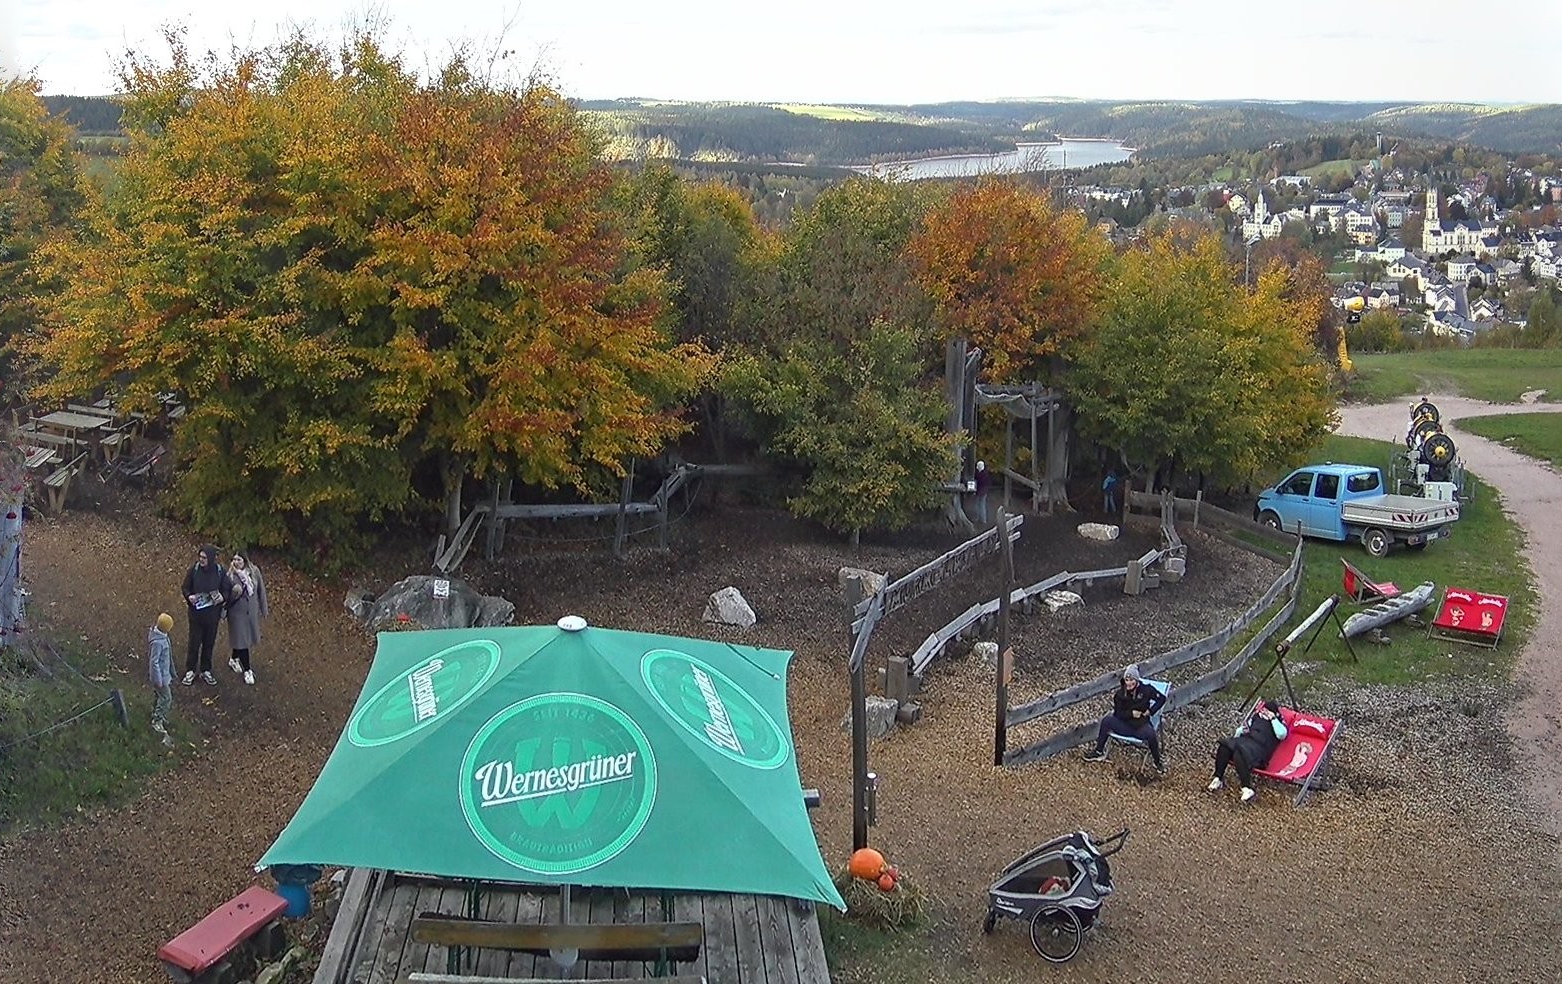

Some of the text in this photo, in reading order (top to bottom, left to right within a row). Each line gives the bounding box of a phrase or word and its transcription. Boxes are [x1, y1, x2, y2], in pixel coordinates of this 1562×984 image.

[412, 659, 444, 721] Wernesgrüner
[690, 662, 739, 752] Wernesgrüner
[475, 751, 637, 801] Wernesgrüner
